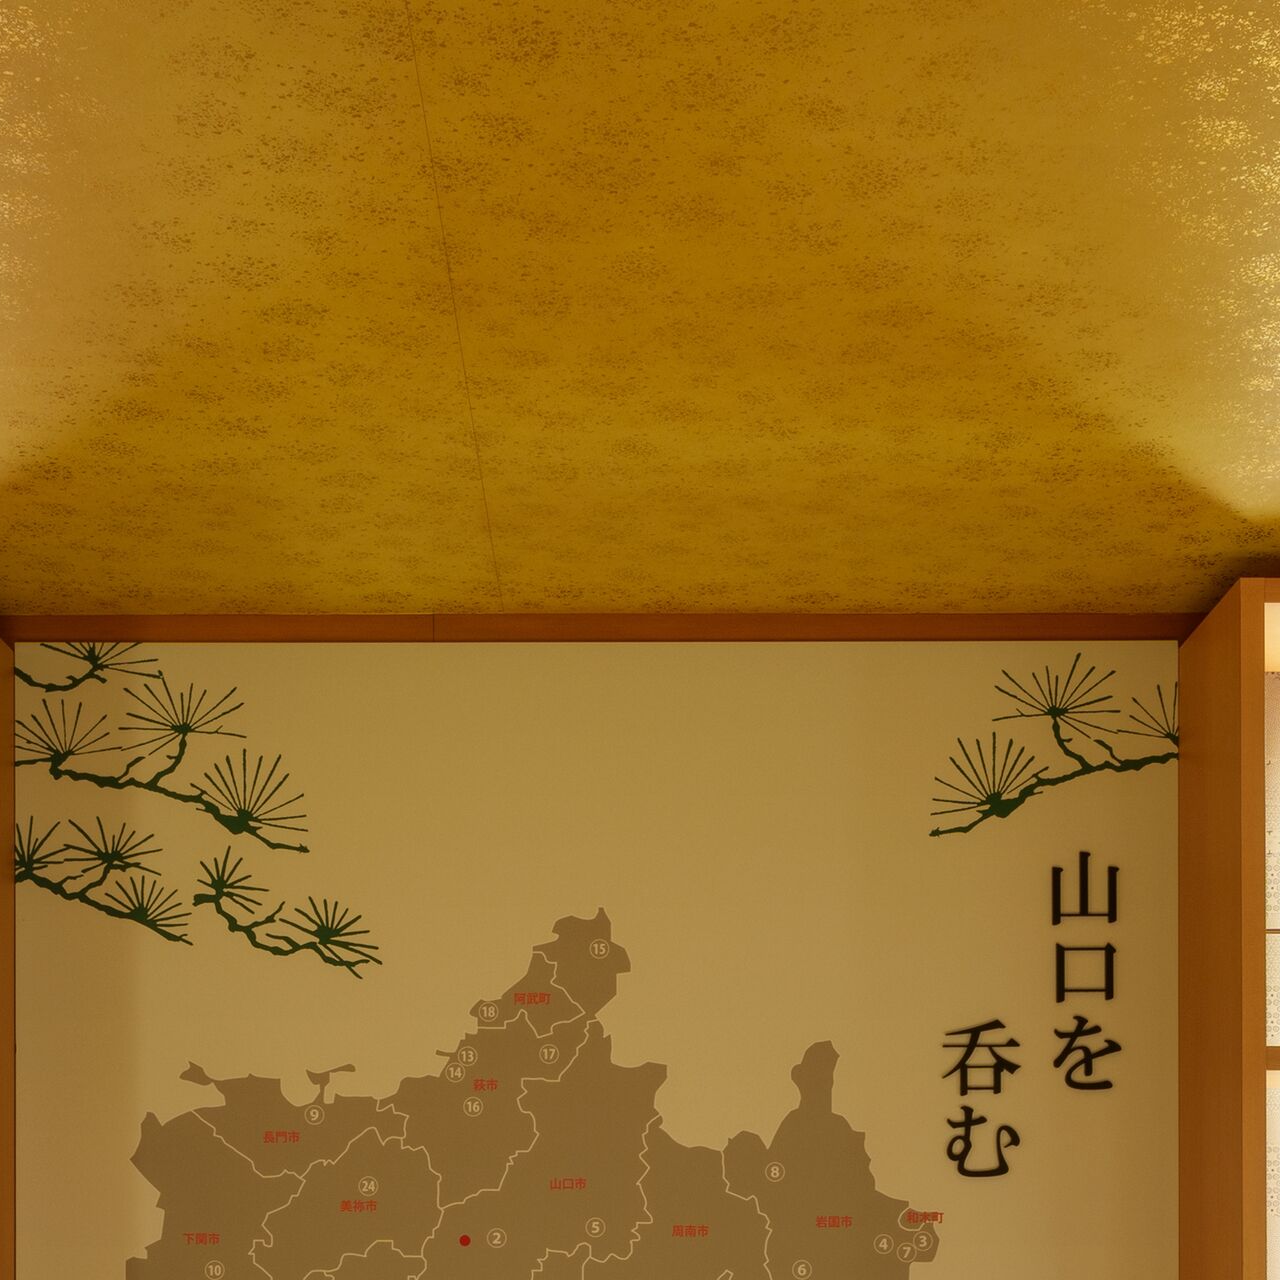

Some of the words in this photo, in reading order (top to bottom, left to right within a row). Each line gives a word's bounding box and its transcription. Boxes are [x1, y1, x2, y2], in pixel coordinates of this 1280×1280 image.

[1052, 851, 1122, 1090] 山口を
[513, 992, 551, 1005] 阿武町
[473, 1078, 498, 1092] 萩市
[942, 1019, 1021, 1177] 呑む
[263, 1131, 300, 1143] 長門市
[549, 1177, 586, 1190] 山口市
[816, 1216, 852, 1228] 岩国市
[907, 1211, 944, 1224] 和木町
[672, 1225, 709, 1238] 周南市
[183, 1233, 220, 1245] 下関市
